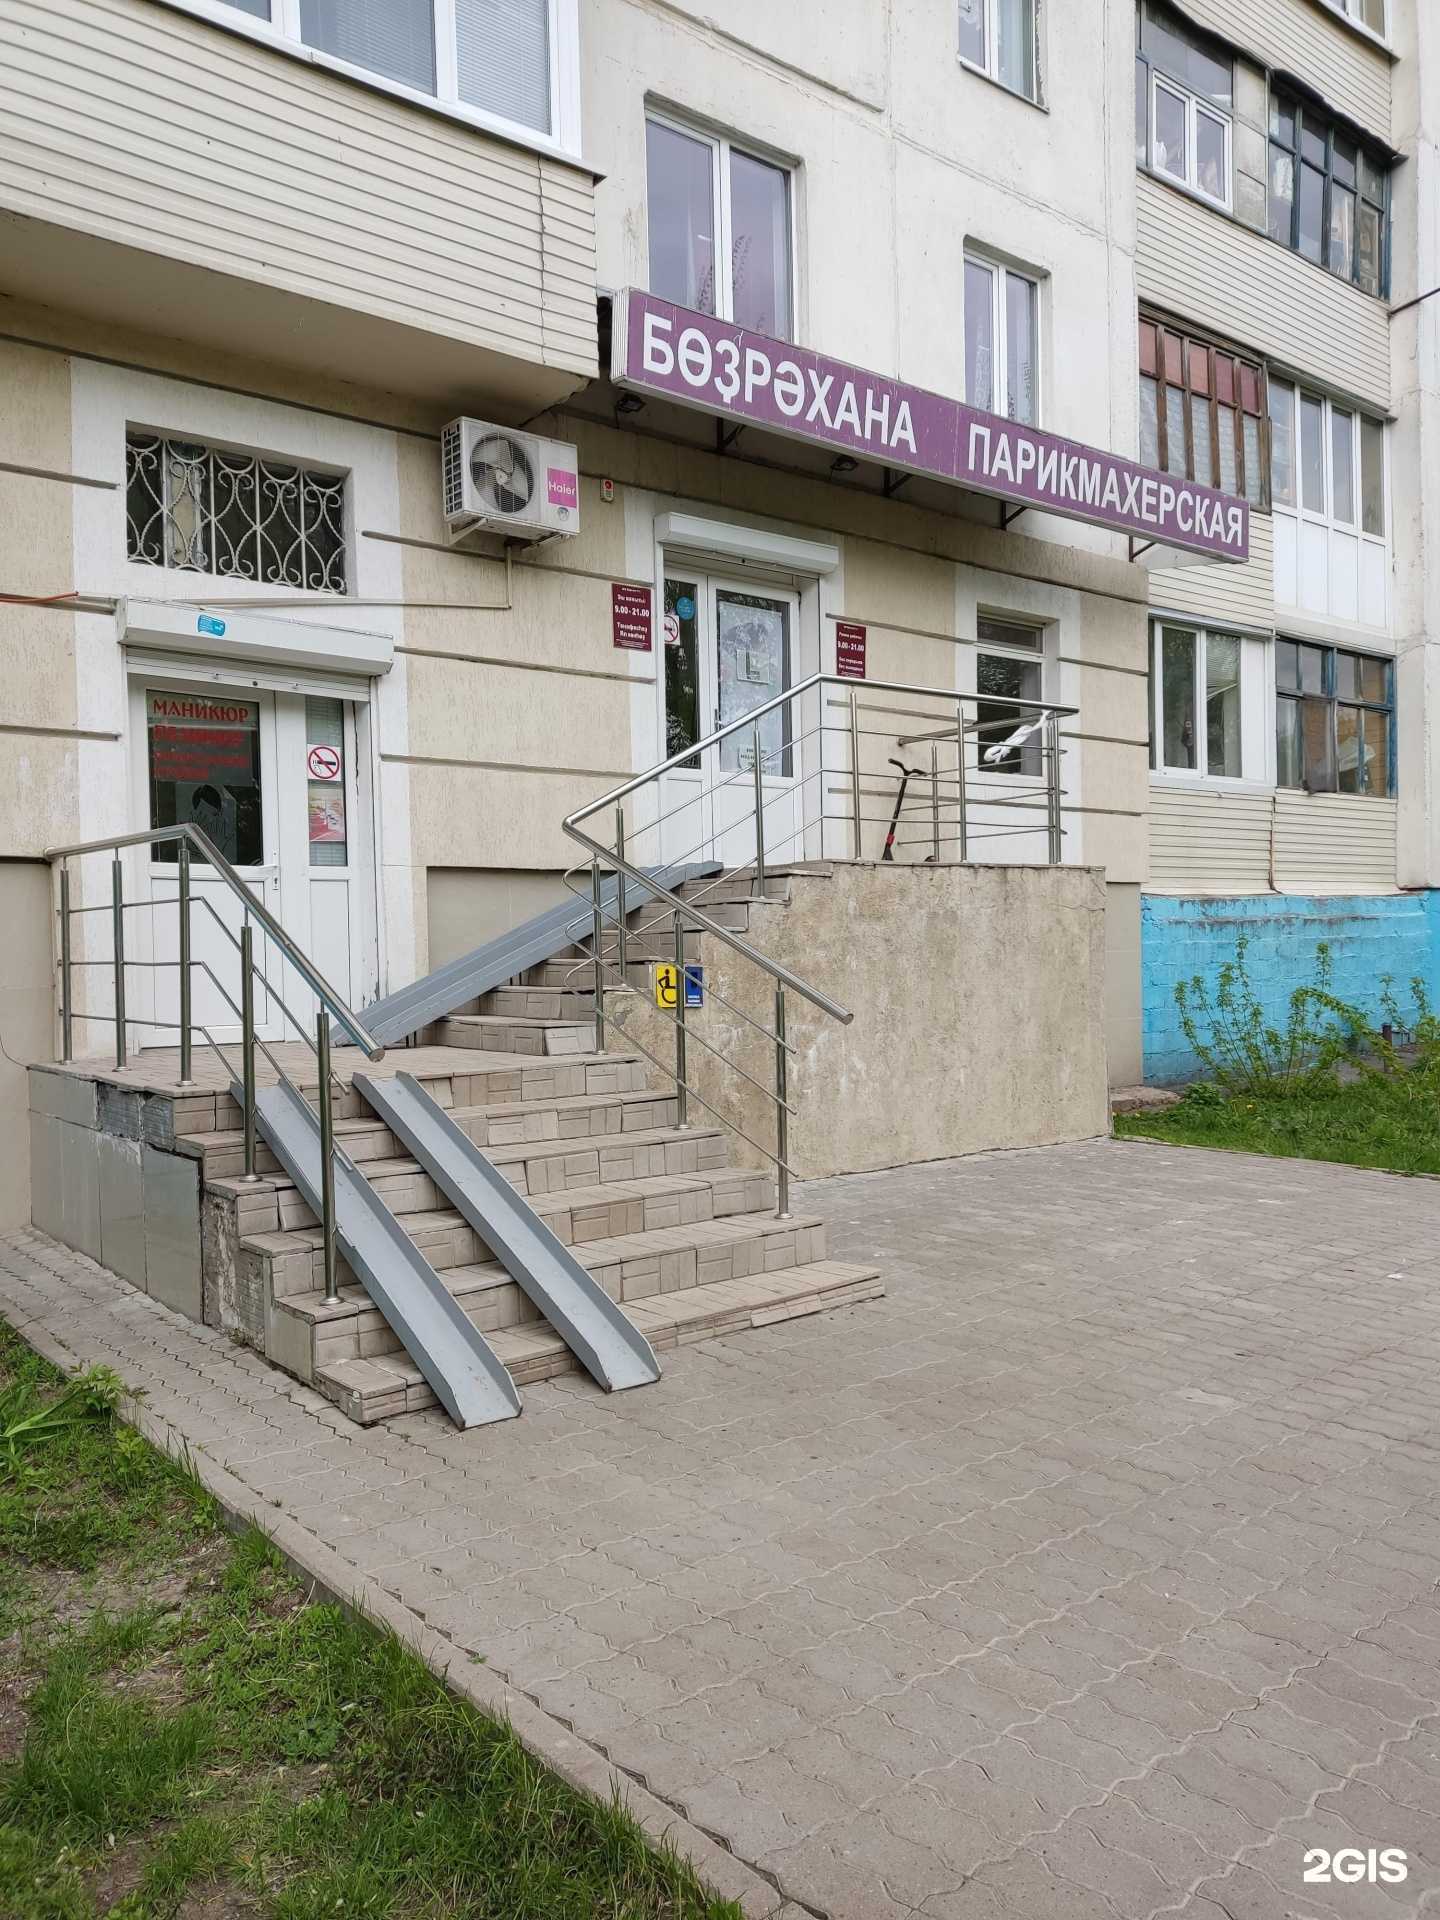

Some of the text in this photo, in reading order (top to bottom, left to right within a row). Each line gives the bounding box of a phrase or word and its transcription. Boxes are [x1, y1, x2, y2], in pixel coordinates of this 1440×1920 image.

[643, 312, 1242, 547] БӨҘРӘХАНА ПАРИКМАХЕРСКАЯ
[548, 480, 575, 495] Haier
[153, 699, 249, 722] МАНИКЮР
